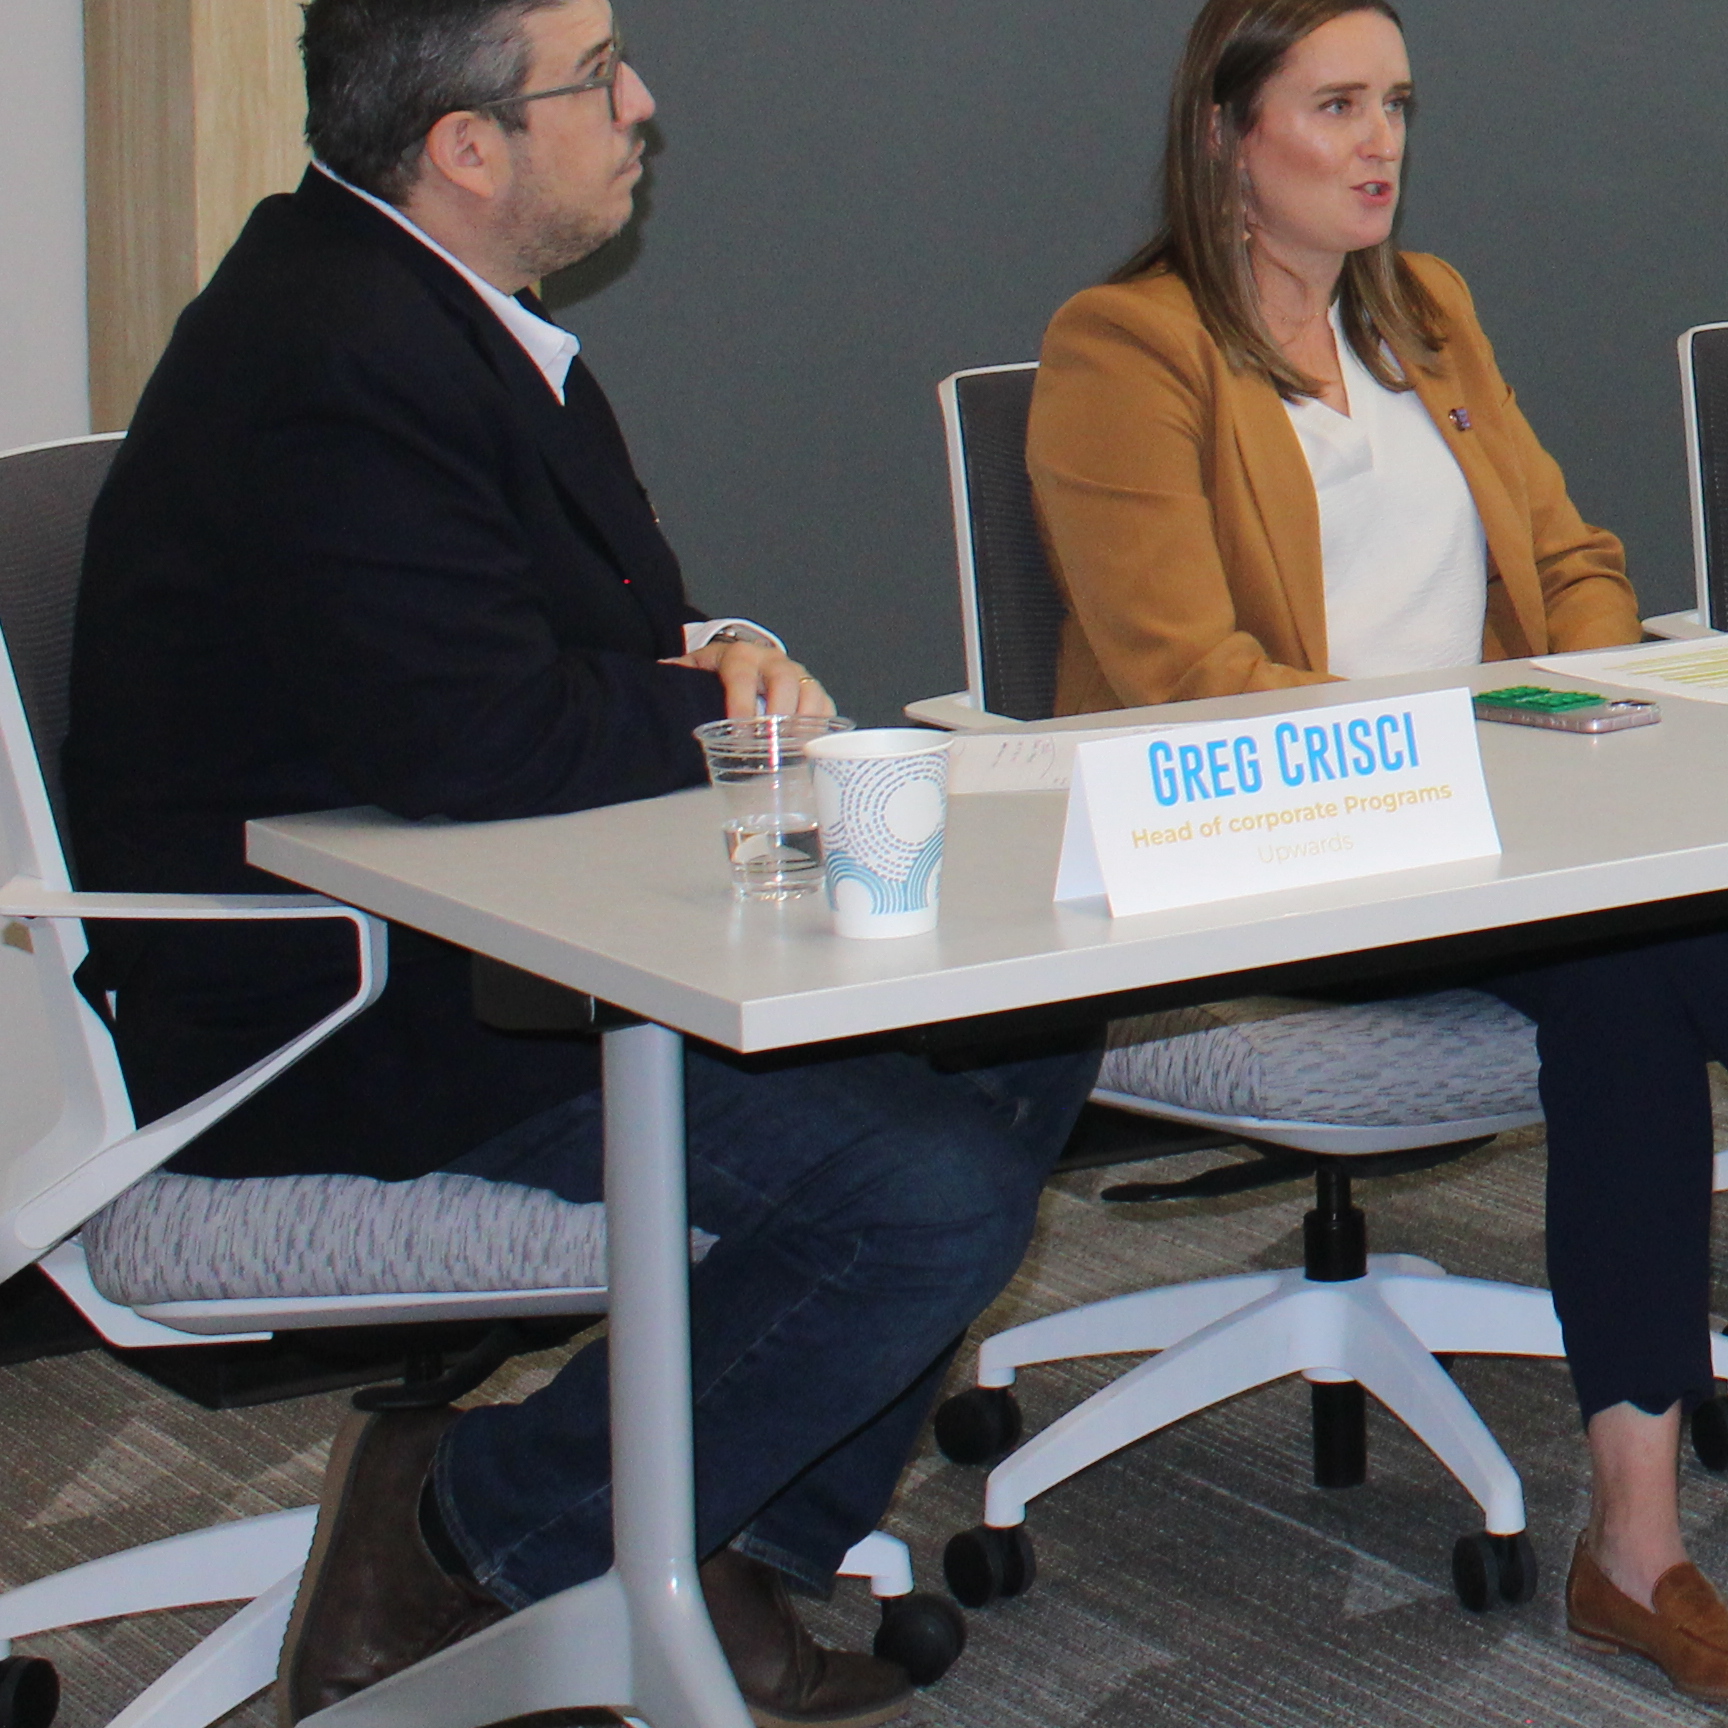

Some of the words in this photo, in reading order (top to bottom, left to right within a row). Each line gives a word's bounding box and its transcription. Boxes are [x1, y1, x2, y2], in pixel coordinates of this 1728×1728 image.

[1149, 735, 1263, 807] GREG
[1275, 711, 1421, 787] CRISCI
[1132, 822, 1193, 849] Head
[1199, 815, 1222, 838] of
[1228, 801, 1339, 833] corporate
[1344, 784, 1454, 815] Programs
[1257, 832, 1355, 864] Upwards
